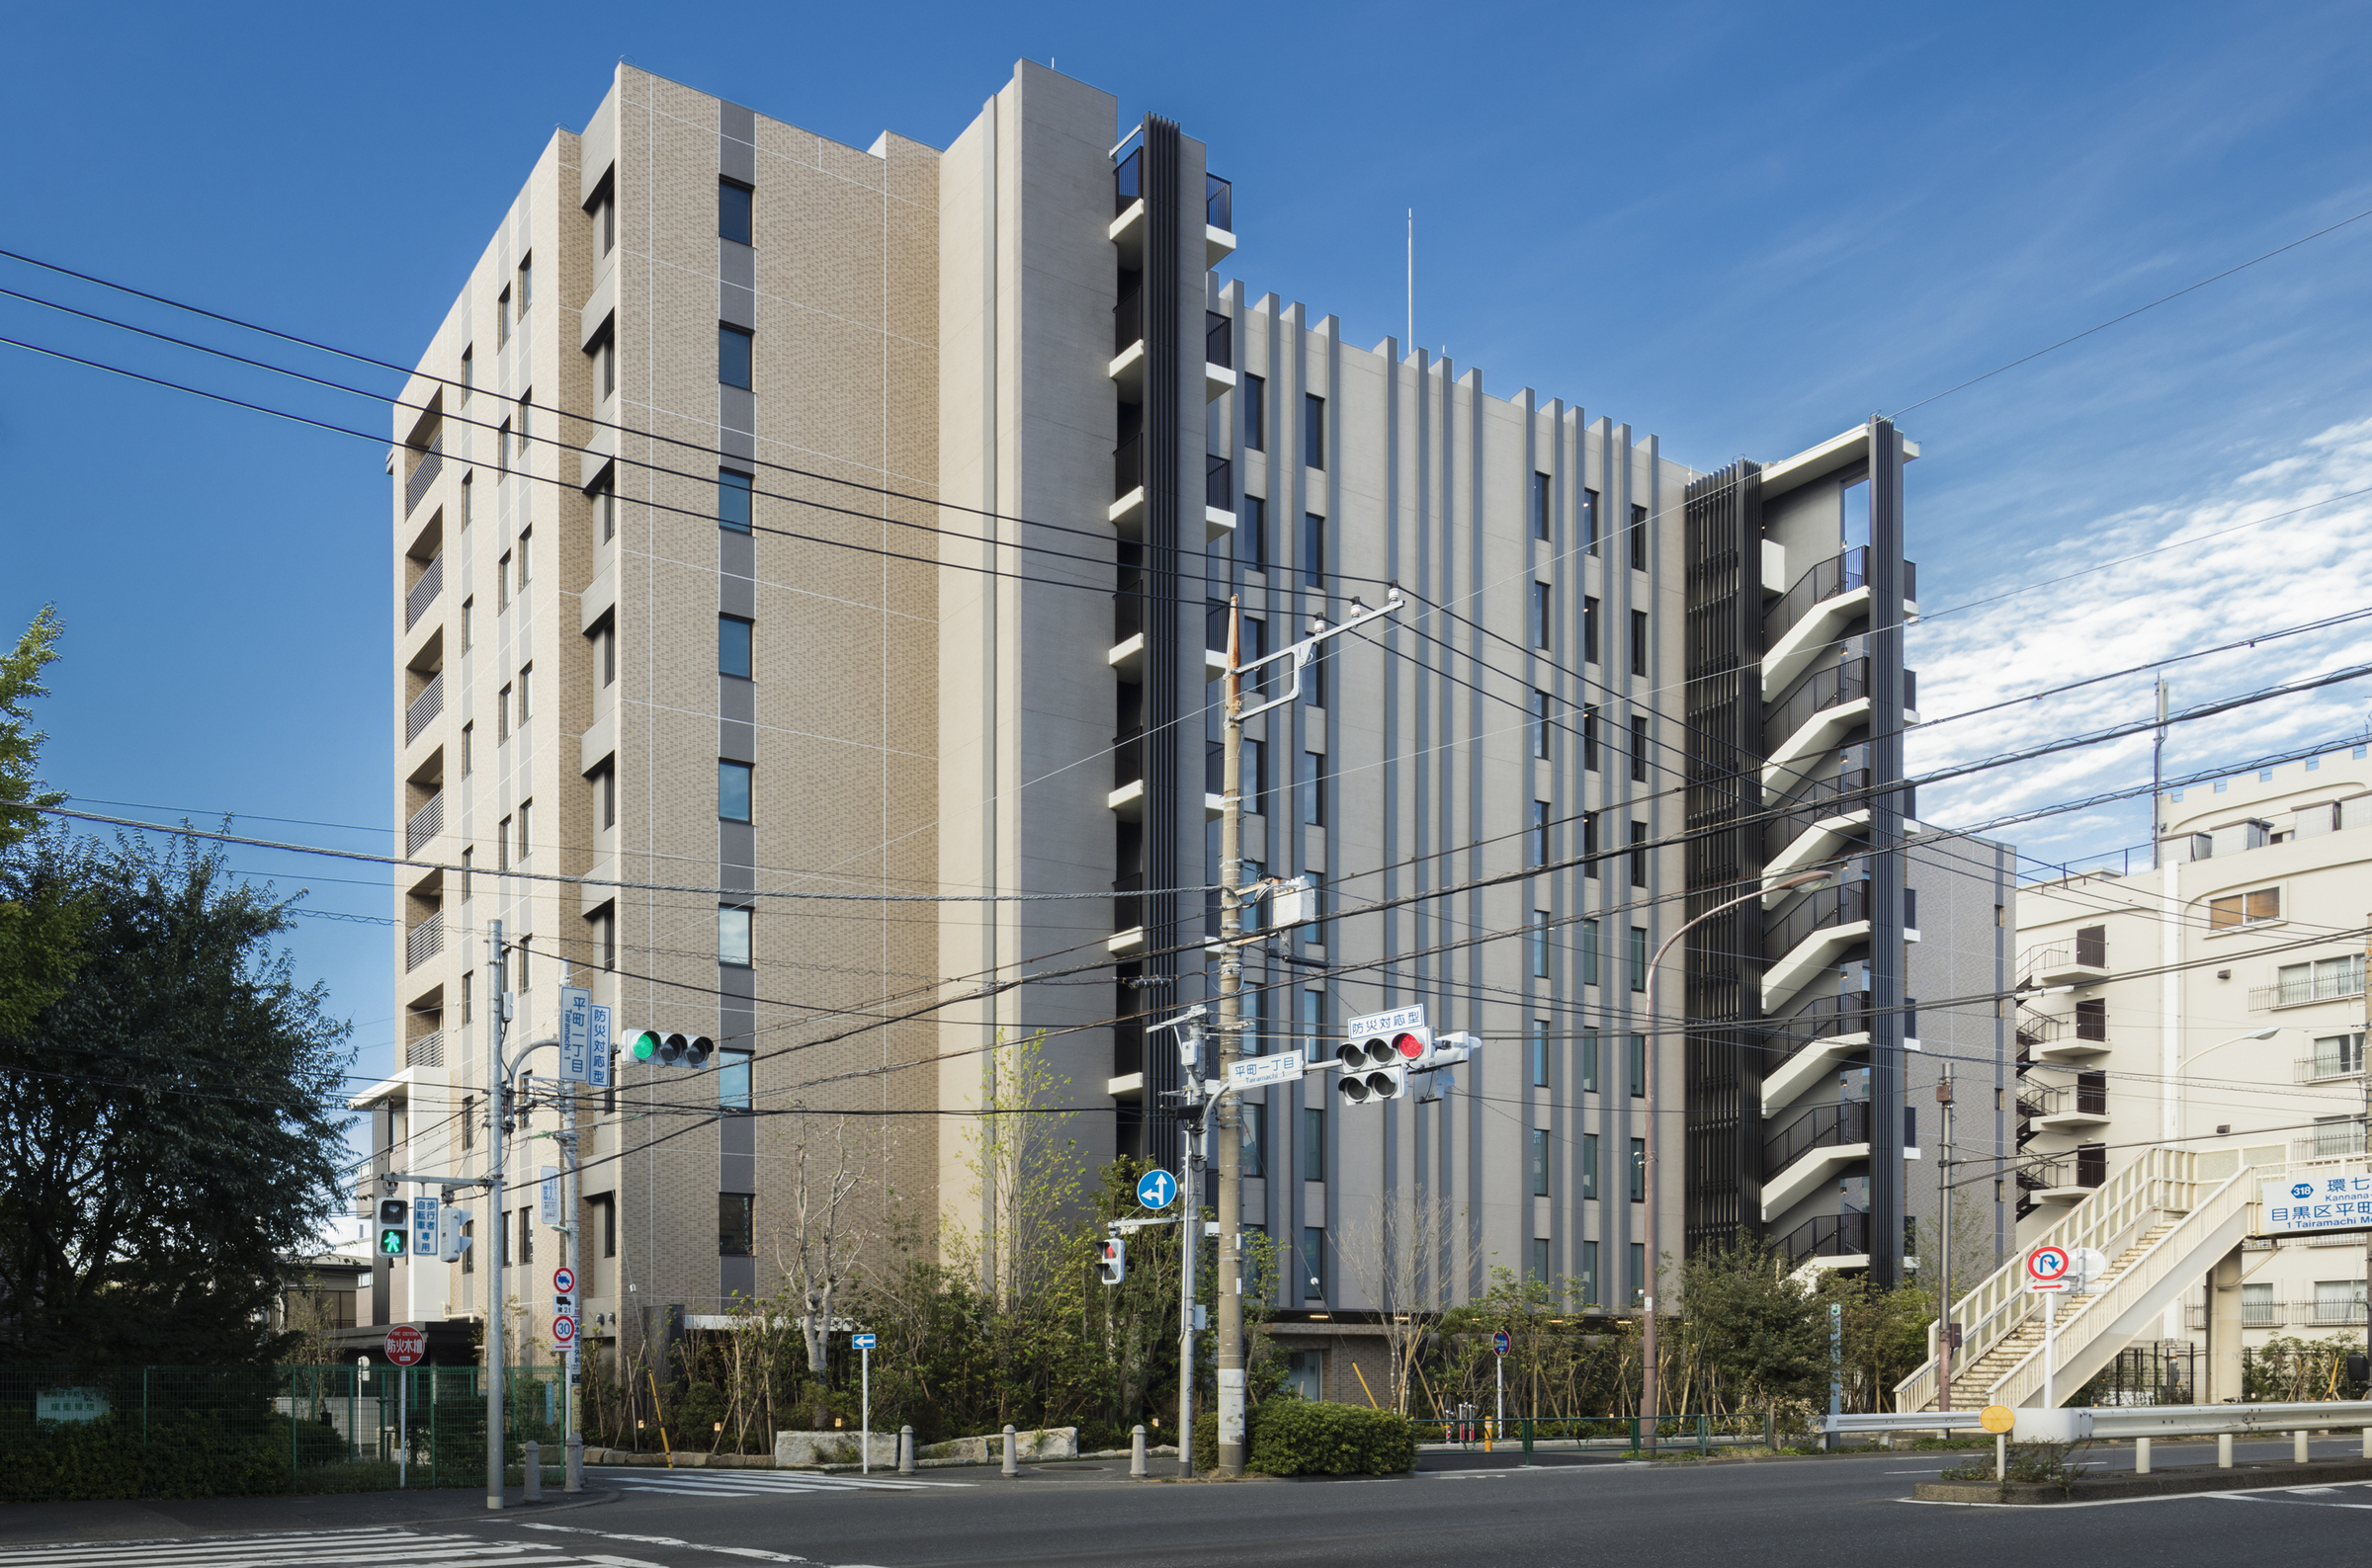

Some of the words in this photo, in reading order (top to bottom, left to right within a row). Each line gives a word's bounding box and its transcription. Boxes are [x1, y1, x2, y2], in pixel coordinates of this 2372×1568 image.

[1352, 1011, 1420, 1034] 防災対応型
[571, 996, 586, 1074] 平町一丁目
[593, 1009, 606, 1083] 防災対応型
[1234, 1056, 1295, 1078] 平町一丁目
[1244, 1072, 1279, 1084] Tairamachi
[2293, 1186, 2312, 1197] 318
[2327, 1177, 2371, 1193] 環七
[416, 1200, 426, 1230] 自転車
[426, 1200, 436, 1231] 歩行者
[2271, 1201, 2372, 1222] 目黒区平町
[2295, 1216, 2357, 1228] Tairamachi
[421, 1232, 430, 1252] 専用
[557, 1322, 571, 1335] 30
